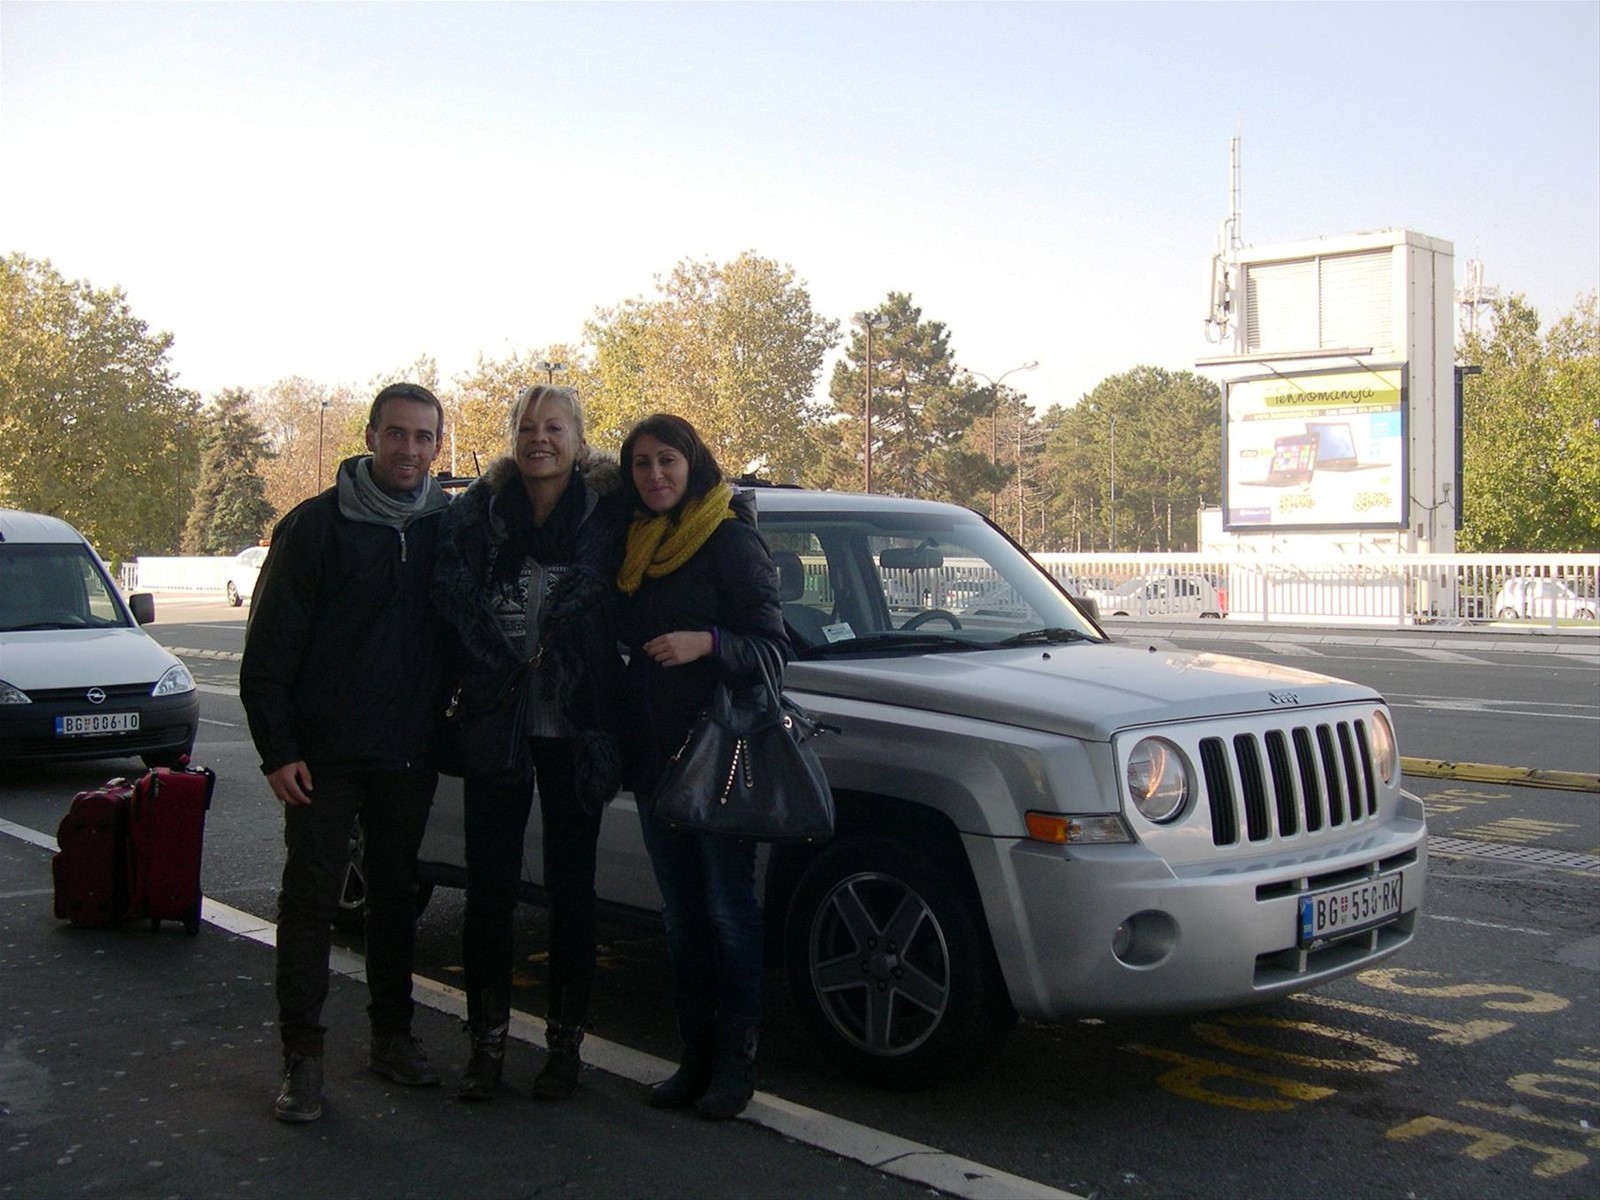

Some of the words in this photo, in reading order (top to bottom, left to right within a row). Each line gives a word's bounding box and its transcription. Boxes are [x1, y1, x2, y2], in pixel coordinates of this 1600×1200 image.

[1268, 692, 1299, 704] Jeep
[66, 718, 82, 731] BG
[1317, 898, 1338, 929] BG
[1121, 968, 1570, 1111] STOP
